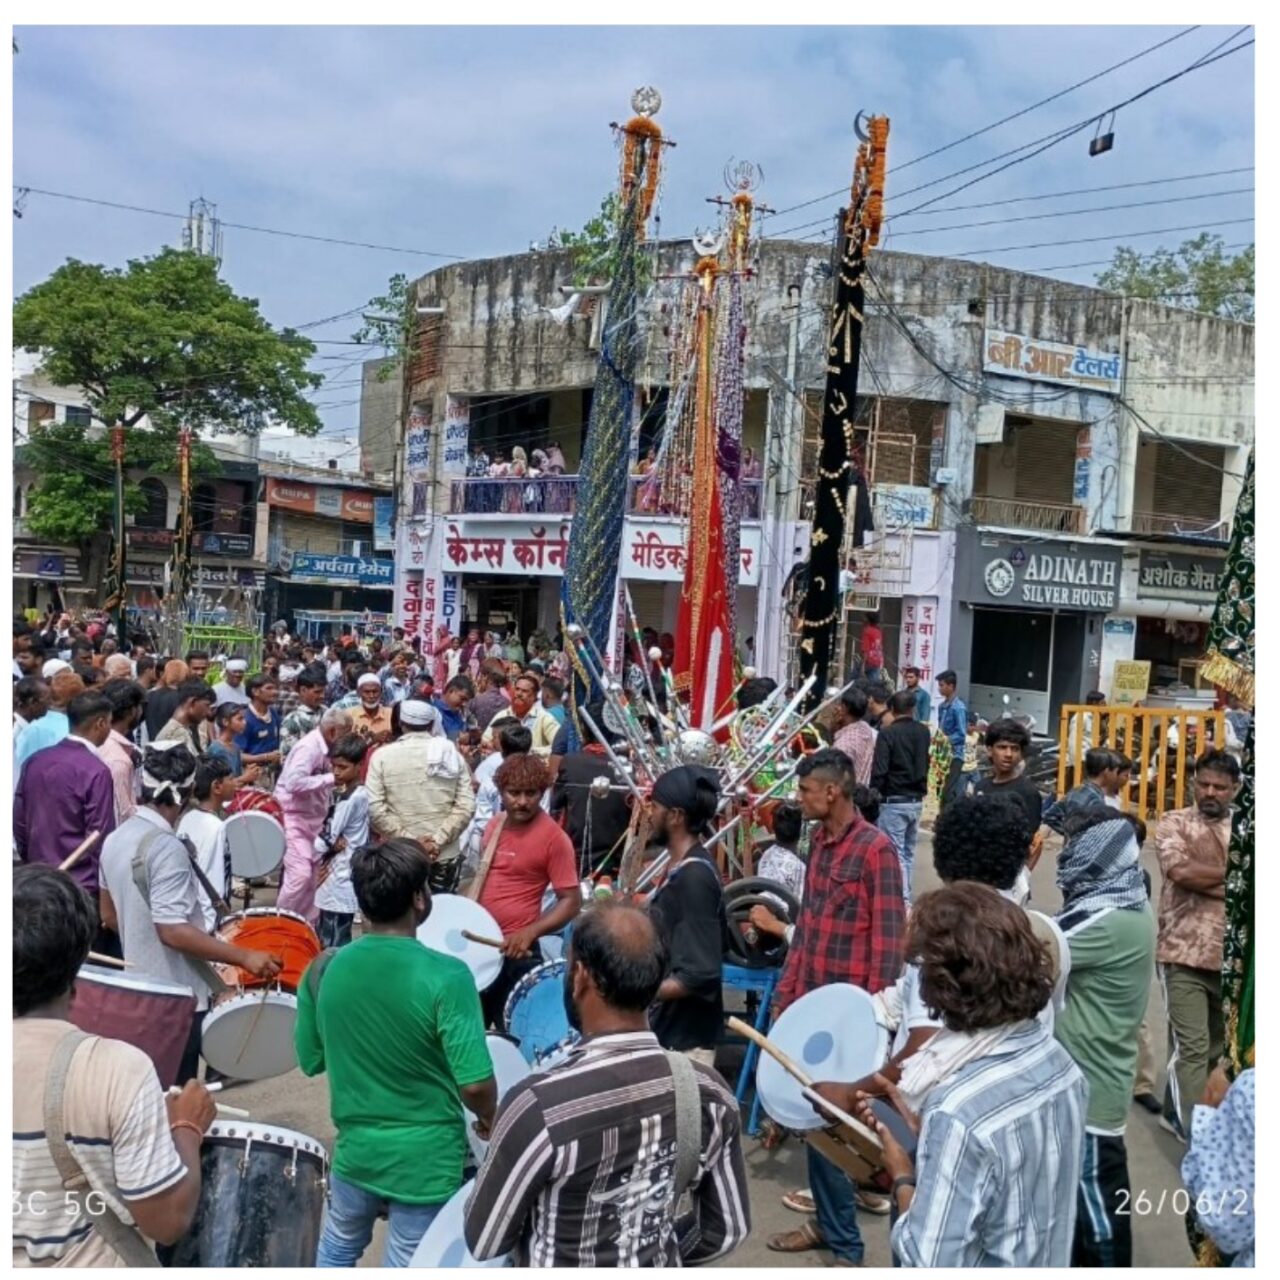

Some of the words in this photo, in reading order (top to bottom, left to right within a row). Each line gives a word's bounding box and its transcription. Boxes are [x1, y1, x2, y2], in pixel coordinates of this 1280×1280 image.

[446, 524, 506, 569] केम्स
[1024, 554, 1117, 587] ADINATH
[1141, 561, 1188, 588] अशोक
[1190, 563, 1216, 590] गैस
[443, 575, 457, 634] MEDI
[1022, 584, 1069, 605] SILVER
[1072, 587, 1115, 608] HOUSE
